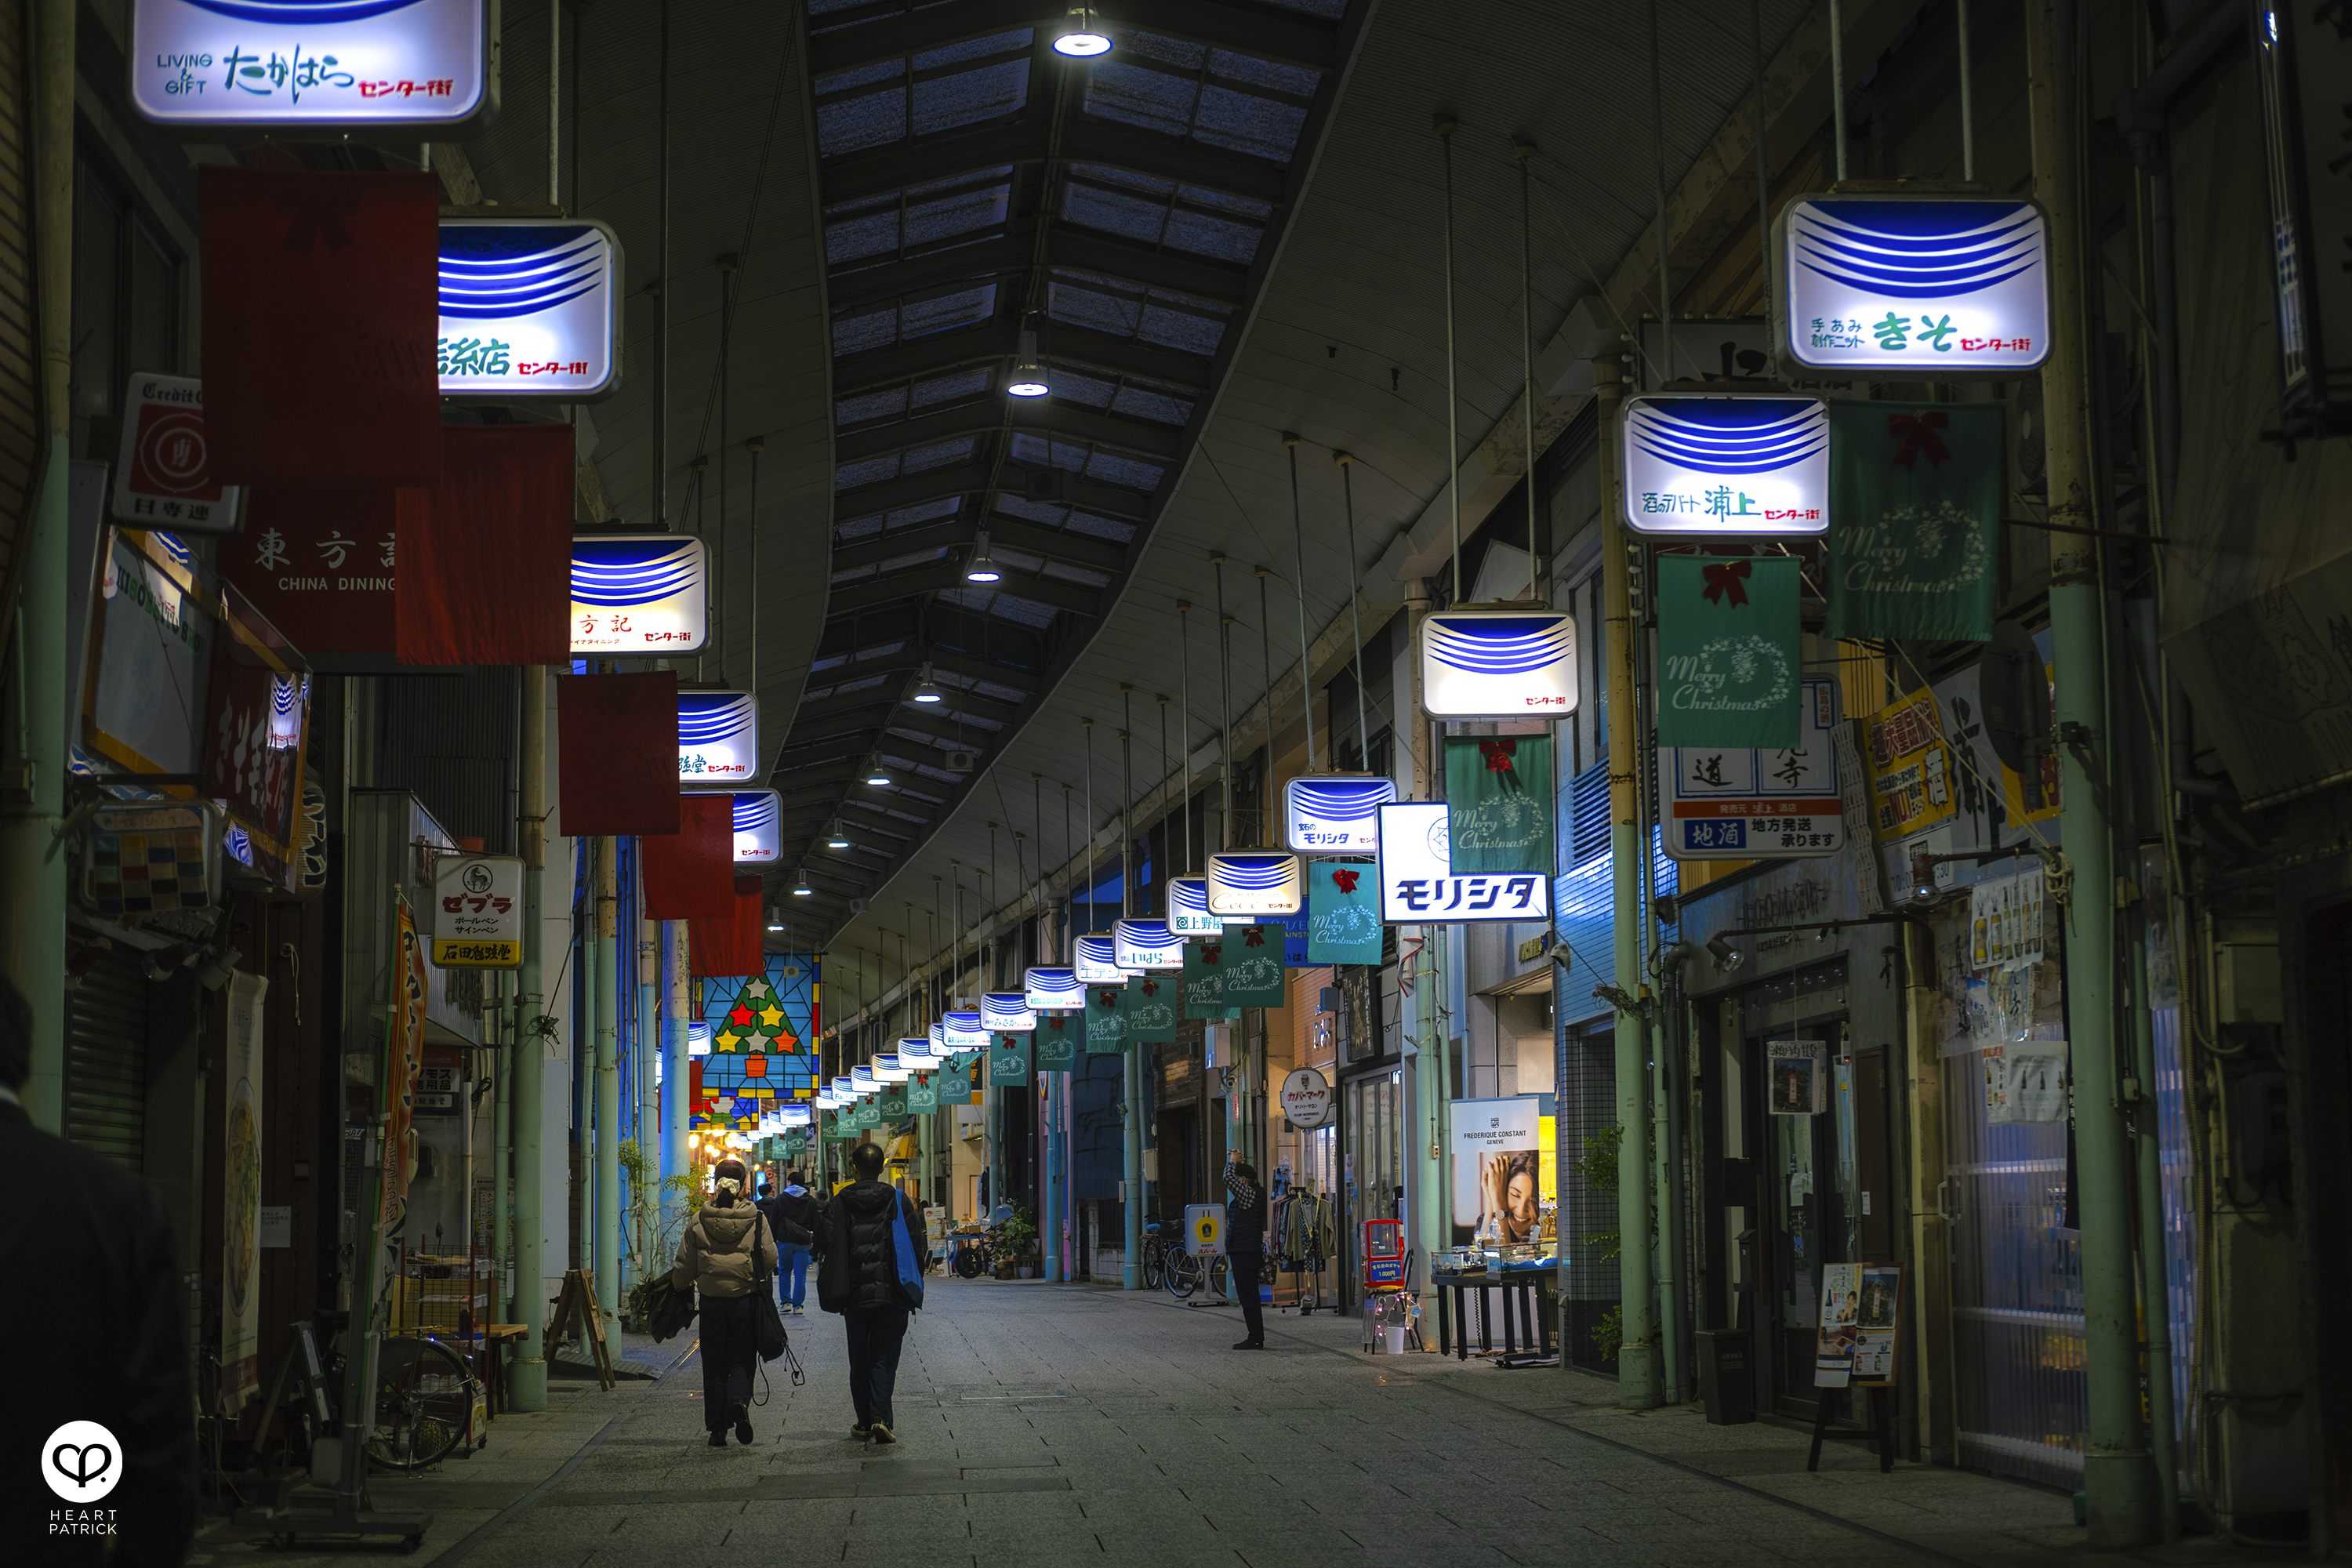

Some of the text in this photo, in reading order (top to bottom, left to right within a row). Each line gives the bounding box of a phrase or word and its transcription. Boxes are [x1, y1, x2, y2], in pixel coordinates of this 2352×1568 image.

[158, 53, 213, 68] LIVING
[180, 68, 194, 81] &
[223, 42, 455, 105] たかはら センター街
[165, 81, 207, 96] GIFT
[1811, 317, 1863, 333] 手あみ
[1873, 311, 2032, 353] きそ センター街
[517, 361, 588, 376] センター街
[142, 382, 194, 404] Credit
[134, 497, 212, 521] 日専連
[1704, 485, 1762, 523] 浦上
[1764, 509, 1820, 521] センター街
[1838, 525, 1907, 566] Merry
[278, 577, 328, 591] CHINA
[1844, 561, 1949, 593] Christmas
[644, 632, 691, 642] センター街
[1666, 655, 1726, 690] Merry
[1526, 697, 1566, 706] センター街
[1671, 684, 1761, 711] Christmas
[1818, 685, 1831, 724] 広島の酒
[1719, 802, 1798, 815] 発売元 浦上 酒店
[1298, 823, 1316, 832] 宝石の
[1454, 809, 1497, 833] Merry
[1751, 818, 1812, 833] 地方発送
[1304, 833, 1349, 844] モリシタ
[1459, 829, 1523, 849] Christmas
[1693, 822, 1739, 847] 地酒
[1781, 833, 1835, 848] 承ります
[1396, 877, 1538, 911] モリシタ
[443, 892, 513, 915] ゼブラ
[455, 926, 499, 935] サインペン
[1189, 916, 1224, 930] 上野屋
[1313, 915, 1345, 934] Merry
[1316, 930, 1363, 946] Christmas
[443, 943, 511, 960] 石田勉強堂
[1132, 952, 1163, 964] いはら
[1081, 968, 1120, 978] エデン
[1226, 967, 1253, 980] Merry
[1187, 982, 1212, 996] Merry
[1229, 980, 1268, 992] Christmas
[1131, 1010, 1152, 1022] Merry
[1088, 1022, 1109, 1034] Merry
[1132, 1021, 1163, 1030] Christmas
[1039, 1044, 1057, 1055] Merry
[1040, 1053, 1069, 1062] Christmas
[993, 1061, 1009, 1071] Merry
[414, 1095, 445, 1104] 勉強堂
[1287, 1089, 1326, 1102] カバーマーク
[1464, 1131, 1497, 1139] FREDERIQUE
